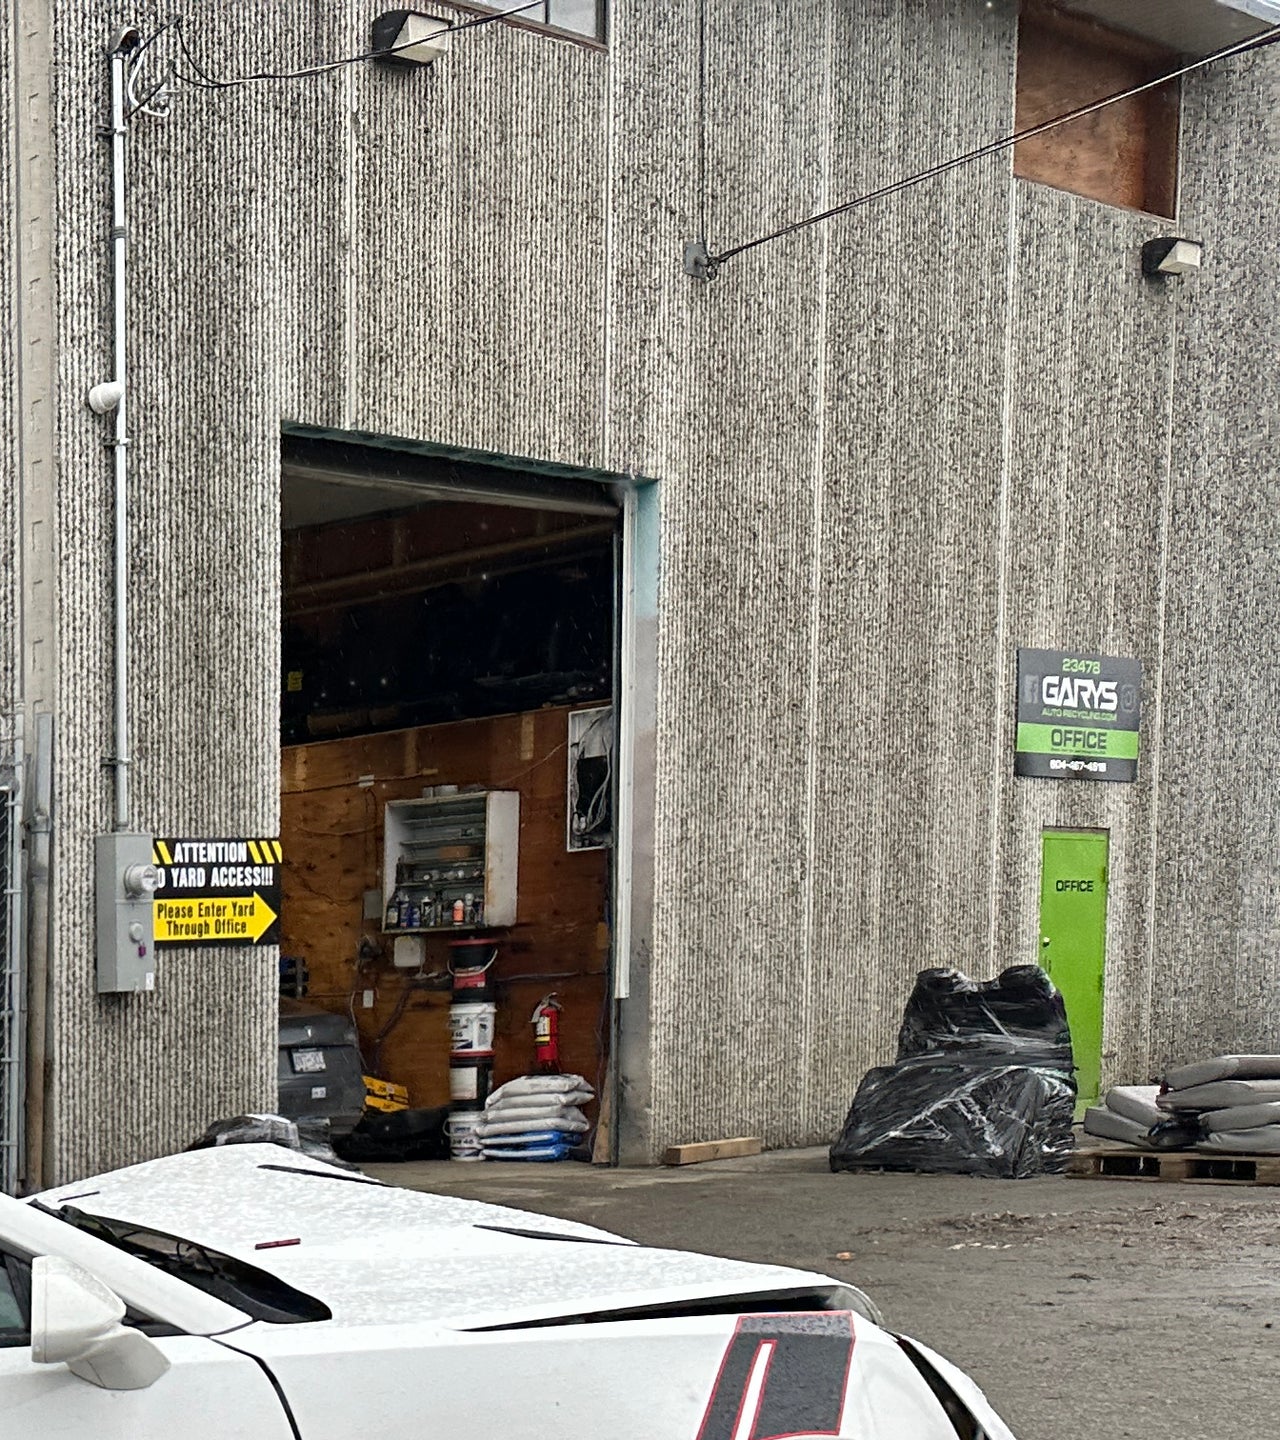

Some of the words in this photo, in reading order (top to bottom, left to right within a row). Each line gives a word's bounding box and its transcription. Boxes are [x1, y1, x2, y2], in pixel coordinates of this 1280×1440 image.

[1062, 658, 1101, 674] 23478
[1042, 675, 1118, 712] GARYS
[1051, 728, 1107, 749] OFFICE
[173, 842, 247, 863] ATTENTION
[171, 867, 205, 888] YARD
[210, 866, 274, 887] ACCESS!!!
[1056, 880, 1094, 892] OFFICE
[158, 903, 193, 920] Please
[198, 903, 227, 918] Enter
[232, 901, 255, 917] Yard
[166, 920, 209, 938] Through
[214, 918, 247, 934] Office
